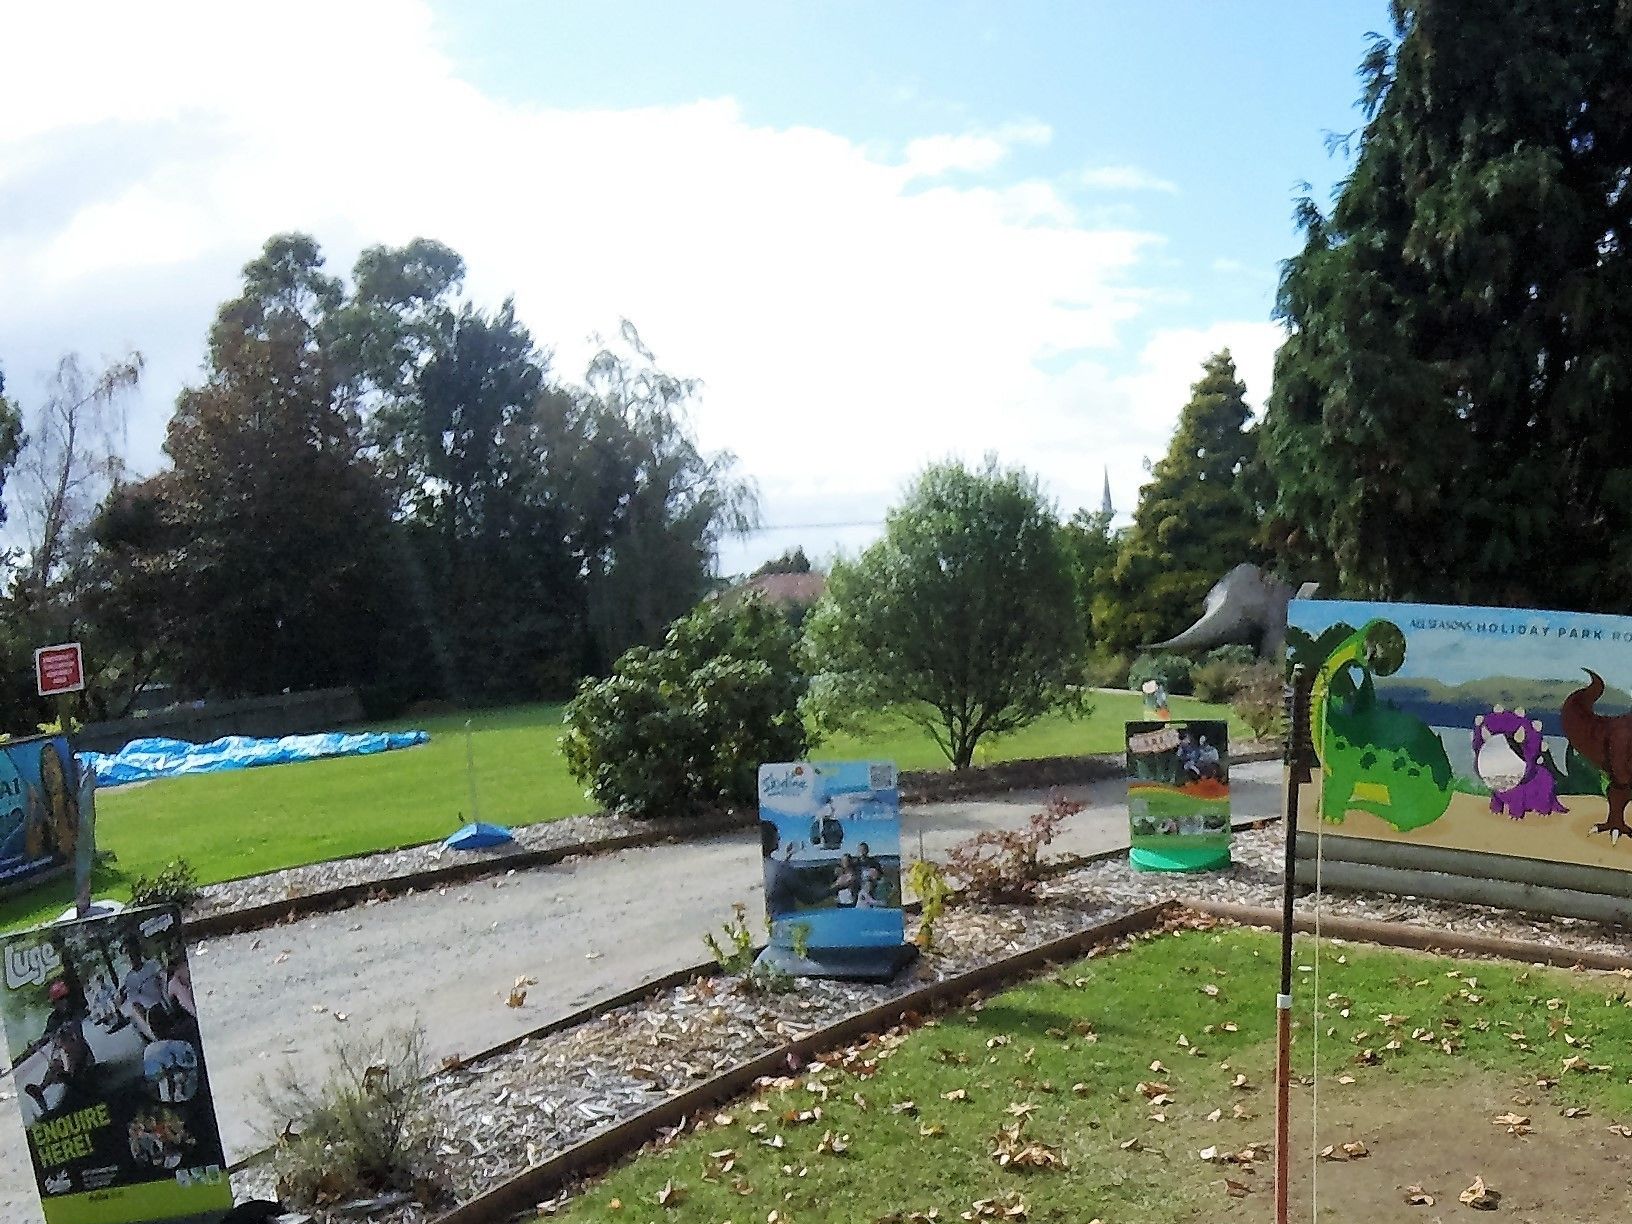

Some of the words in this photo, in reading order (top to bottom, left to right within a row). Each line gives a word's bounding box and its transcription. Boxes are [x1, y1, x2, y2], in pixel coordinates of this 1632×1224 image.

[1476, 622, 1550, 638] HOLIDAY
[1557, 626, 1602, 641] PARK
[5, 943, 60, 989] Luge
[33, 1103, 111, 1146] ENQUIRE
[37, 1132, 94, 1168] HERE!
